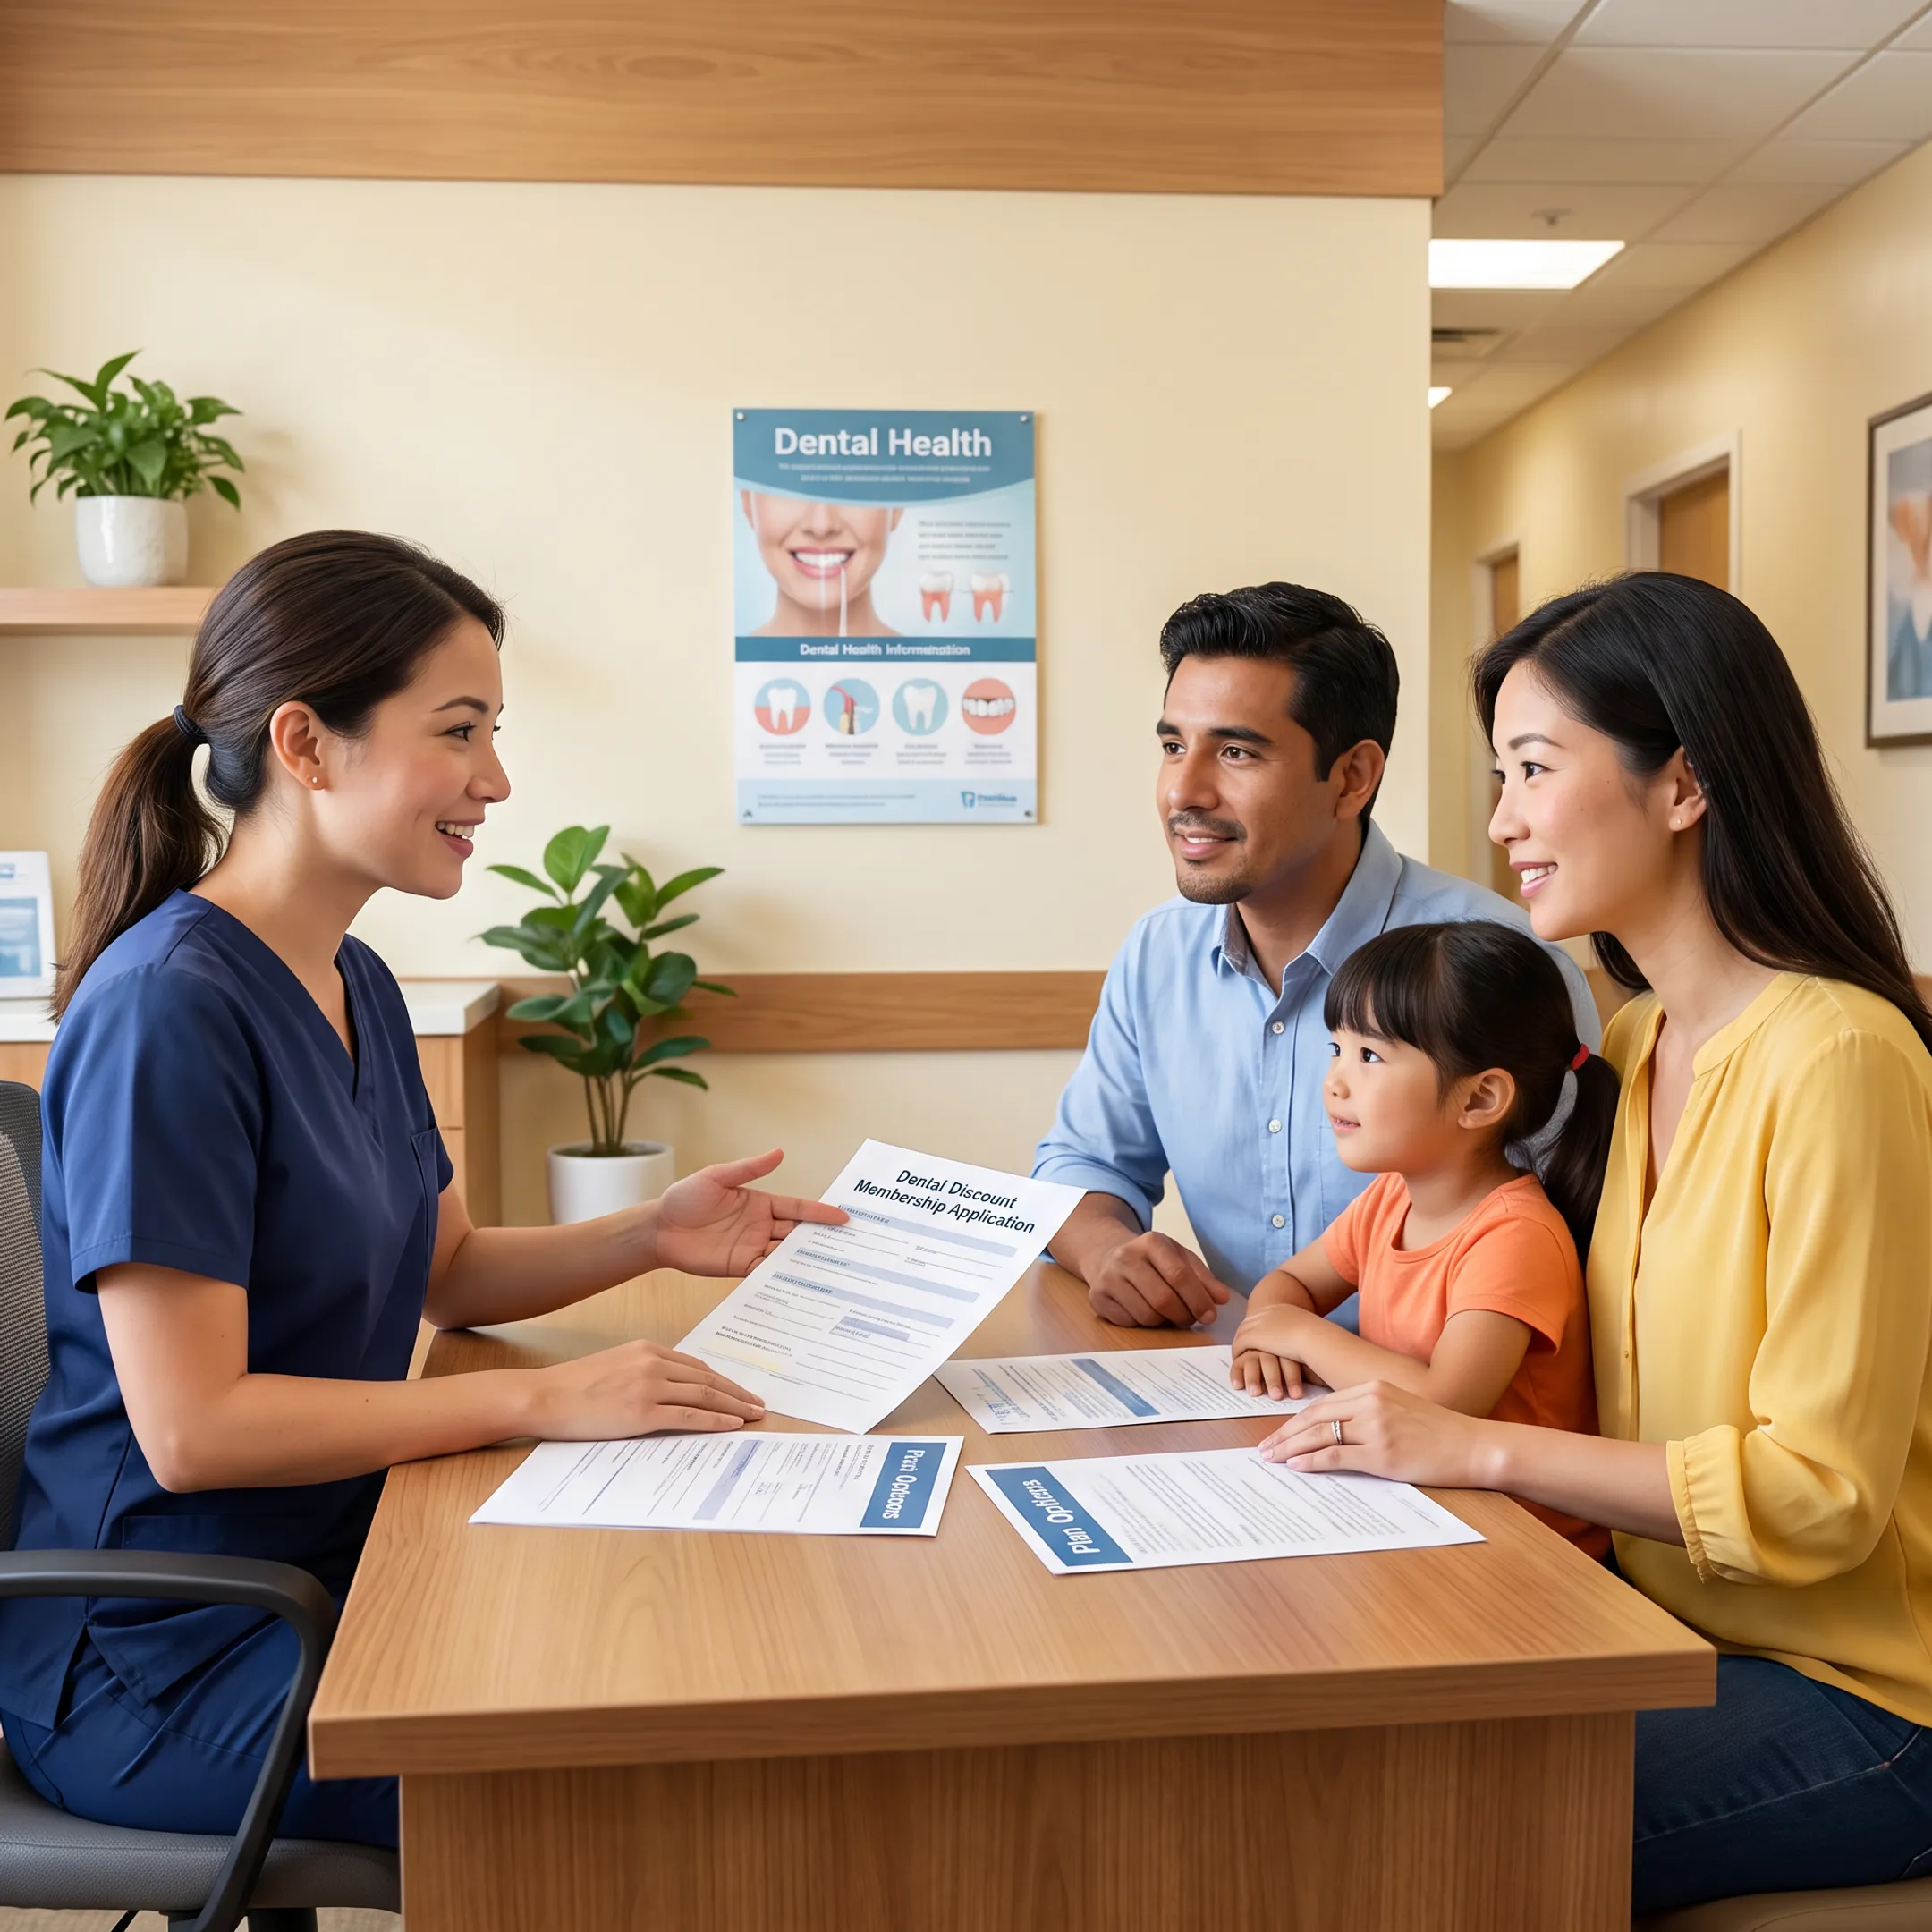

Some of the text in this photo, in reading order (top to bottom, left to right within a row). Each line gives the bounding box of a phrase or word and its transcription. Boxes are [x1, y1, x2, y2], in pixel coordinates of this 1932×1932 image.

[775, 428, 993, 458] Dental Health
[800, 643, 840, 656] Dental
[843, 643, 882, 656] Health
[895, 1169, 1018, 1209] Dental Discount
[853, 1178, 948, 1216] Membership
[946, 1203, 1036, 1234] Application
[1063, 1527, 1101, 1555] Plan
